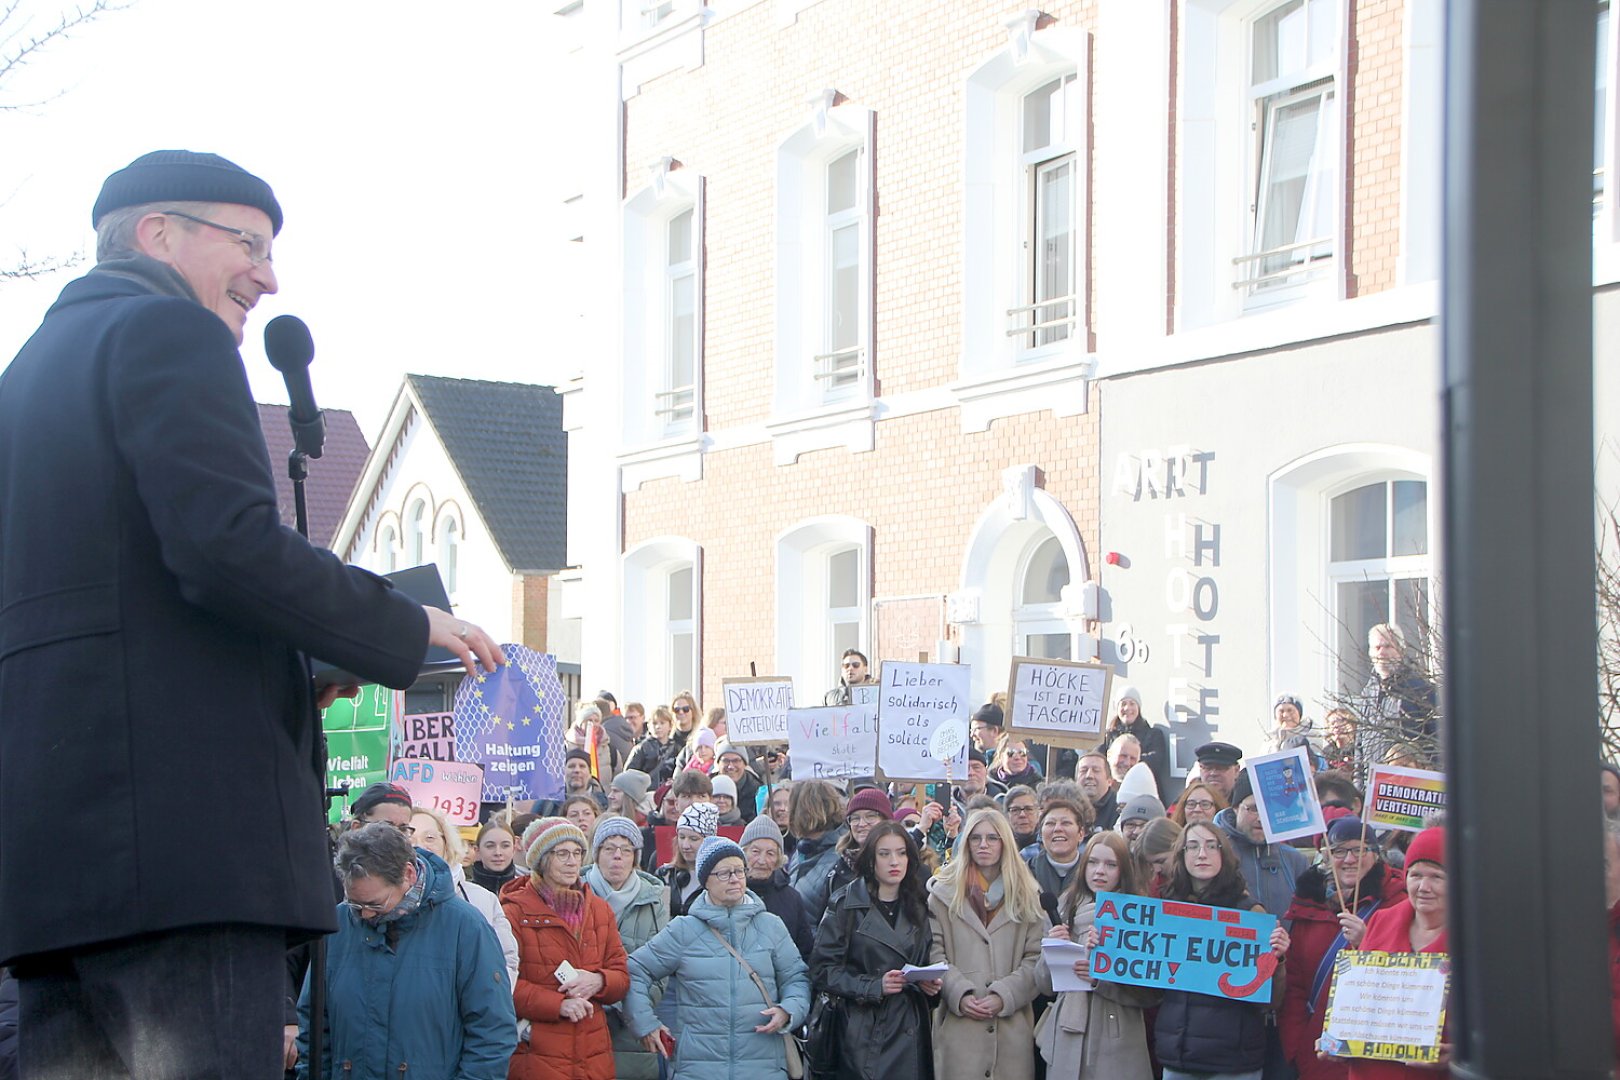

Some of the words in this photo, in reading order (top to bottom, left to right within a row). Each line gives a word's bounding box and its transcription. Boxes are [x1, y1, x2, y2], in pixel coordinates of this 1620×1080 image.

[892, 669, 943, 687] Lieber
[1031, 667, 1090, 692] HÖCKE
[888, 694, 958, 714] solidarisch
[1034, 691, 1052, 702] IST
[1058, 693, 1084, 706] EIN
[733, 714, 789, 734] VERTEIDIGE
[907, 714, 929, 727] als
[1027, 704, 1100, 726] FASCHIST
[800, 713, 878, 739] Vielfalt
[485, 743, 541, 758] Haltung
[327, 755, 369, 771] Vielfalt
[393, 762, 433, 784] AFD
[491, 760, 535, 775] zeigen
[813, 762, 869, 779] Rechts
[432, 796, 478, 821] 1933
[1096, 900, 1157, 926] ACH
[1099, 926, 1177, 958] FICKT
[1186, 936, 1261, 968] EUCH
[1094, 951, 1181, 984] DOCH!
